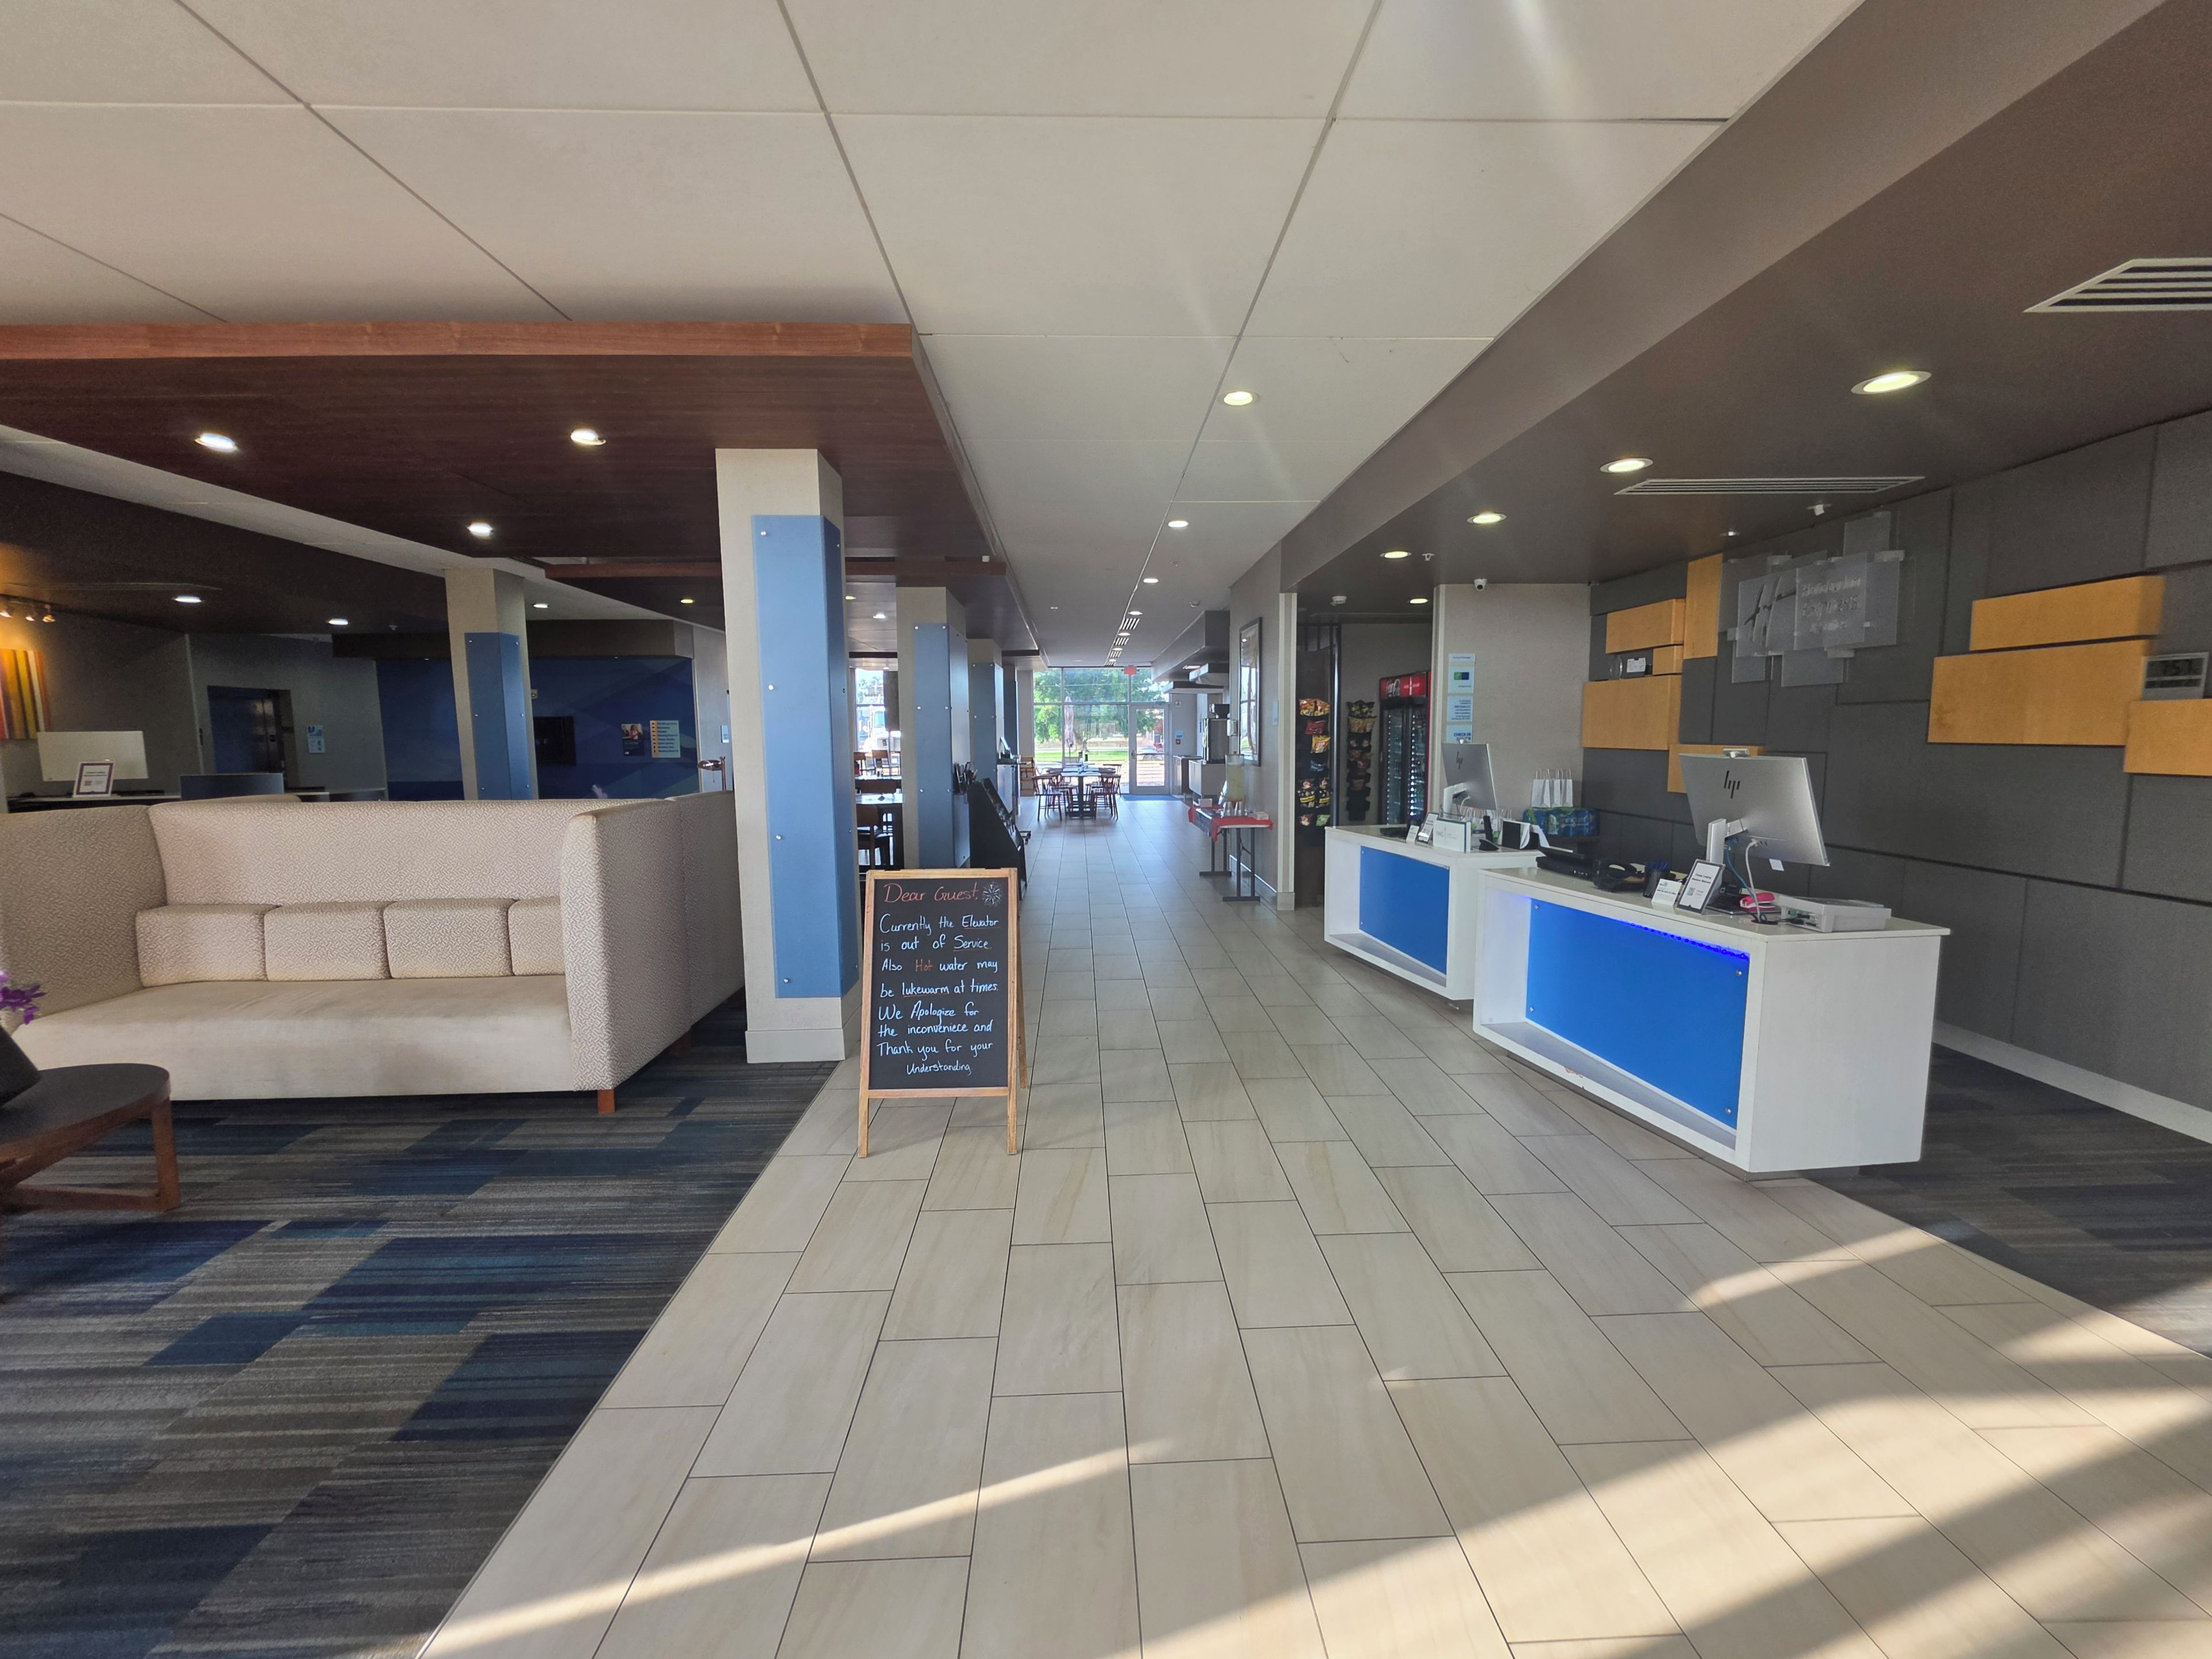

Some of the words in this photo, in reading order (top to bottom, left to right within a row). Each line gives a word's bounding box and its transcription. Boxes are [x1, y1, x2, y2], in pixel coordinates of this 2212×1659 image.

[1724, 770, 1741, 799] hp
[883, 882, 926, 903] Dear
[880, 913, 931, 936] Currently
[938, 915, 955, 929] the
[961, 914, 999, 928] Elevator
[880, 940, 891, 952] is
[901, 936, 919, 950] out
[932, 933, 946, 949] of
[953, 935, 988, 949] Service
[881, 958, 903, 971] Also
[915, 959, 933, 972] Hot
[939, 957, 968, 971] water
[976, 960, 998, 974] may
[880, 983, 895, 998] be
[902, 982, 950, 995] lukewarm
[953, 979, 965, 993] at
[970, 978, 999, 993] times.
[878, 1003, 903, 1021] We
[910, 999, 957, 1026] Apologize
[964, 1001, 979, 1016] for
[877, 1024, 898, 1037] the
[974, 1019, 994, 1032] and
[876, 1040, 914, 1056] Thank
[917, 1046, 939, 1061] you
[945, 1039, 963, 1053] for
[970, 1042, 994, 1058] your
